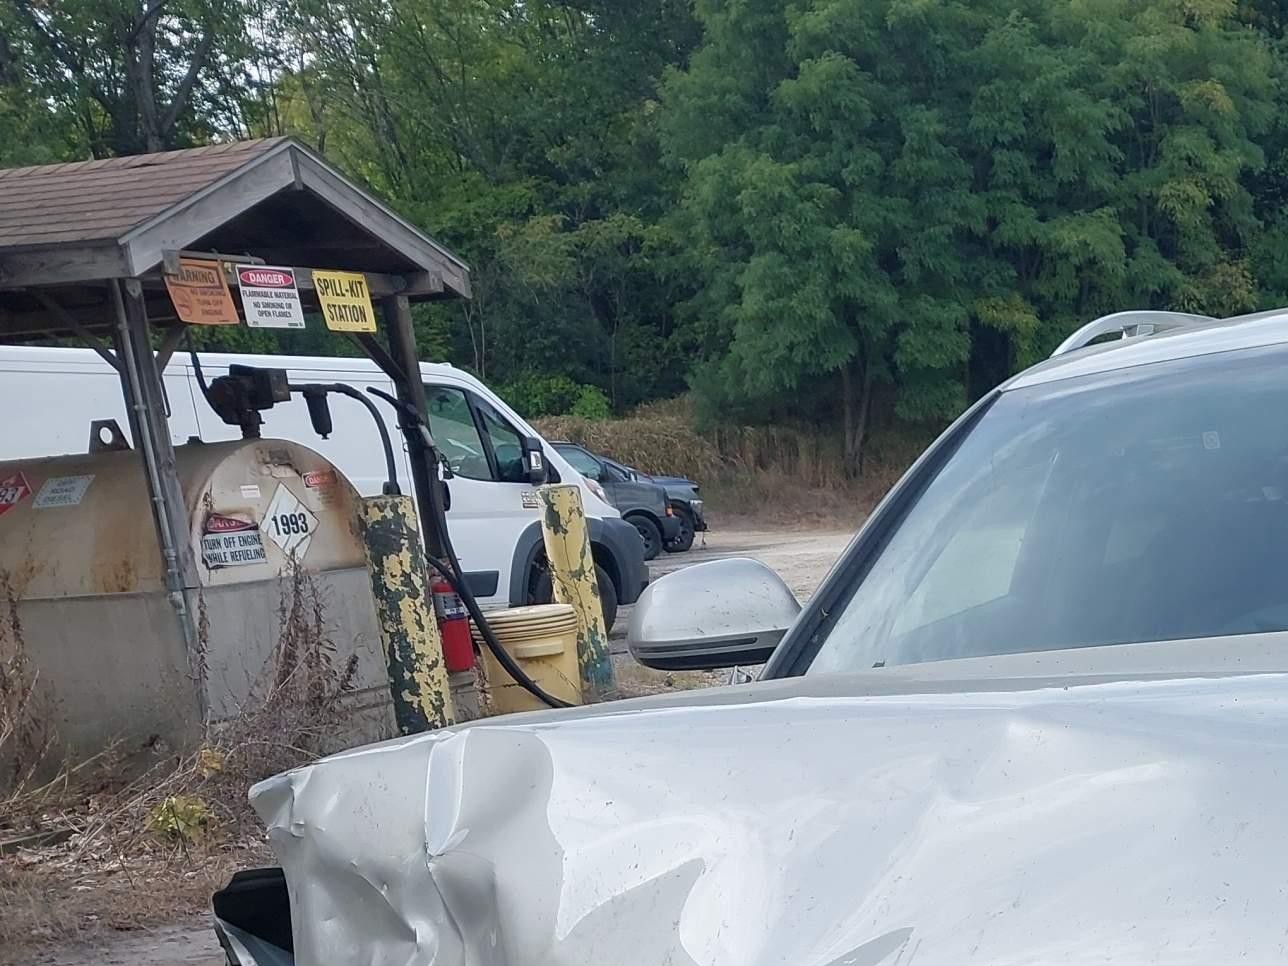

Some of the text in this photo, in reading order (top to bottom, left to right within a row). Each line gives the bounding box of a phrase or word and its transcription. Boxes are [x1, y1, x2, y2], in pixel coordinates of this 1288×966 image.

[248, 272, 285, 285] DANGER
[316, 277, 365, 299] SPILL-KIT
[326, 302, 368, 323] STATION
[271, 512, 309, 536] 1993
[203, 533, 263, 551] TURN OFF ENGINE
[206, 547, 266, 564] WHILE REFUELING
